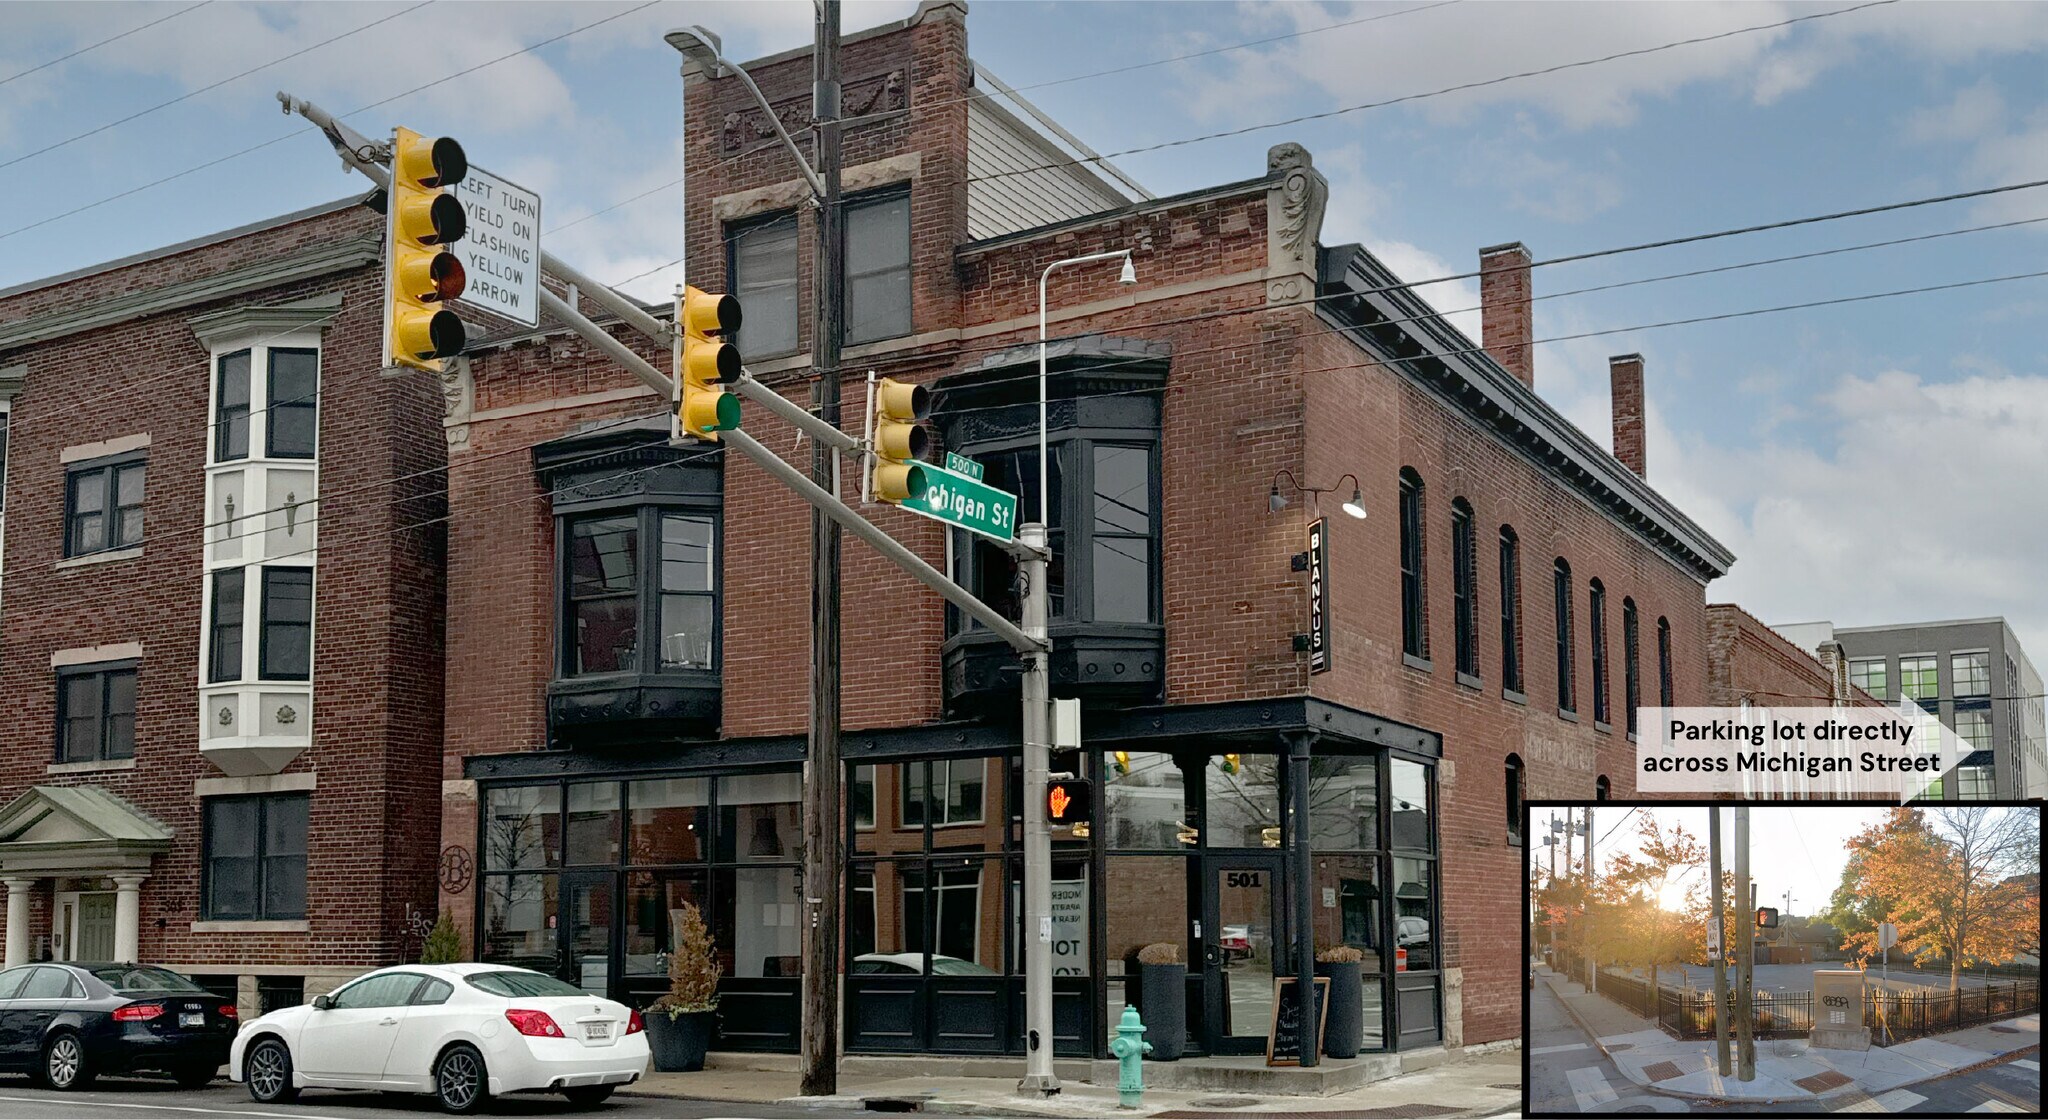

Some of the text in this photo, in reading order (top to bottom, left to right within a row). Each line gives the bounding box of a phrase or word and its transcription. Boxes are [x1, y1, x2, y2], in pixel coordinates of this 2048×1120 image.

[461, 177, 536, 219] LEFT TURN
[465, 200, 530, 240] YIELD ON
[463, 225, 530, 264] FLASHING
[469, 250, 523, 285] YELLOW
[471, 278, 520, 308] ARROW
[952, 458, 978, 477] 500 N
[922, 483, 1009, 529] chigan St
[1311, 533, 1321, 647] BLANKUS
[1227, 872, 1262, 888] 501
